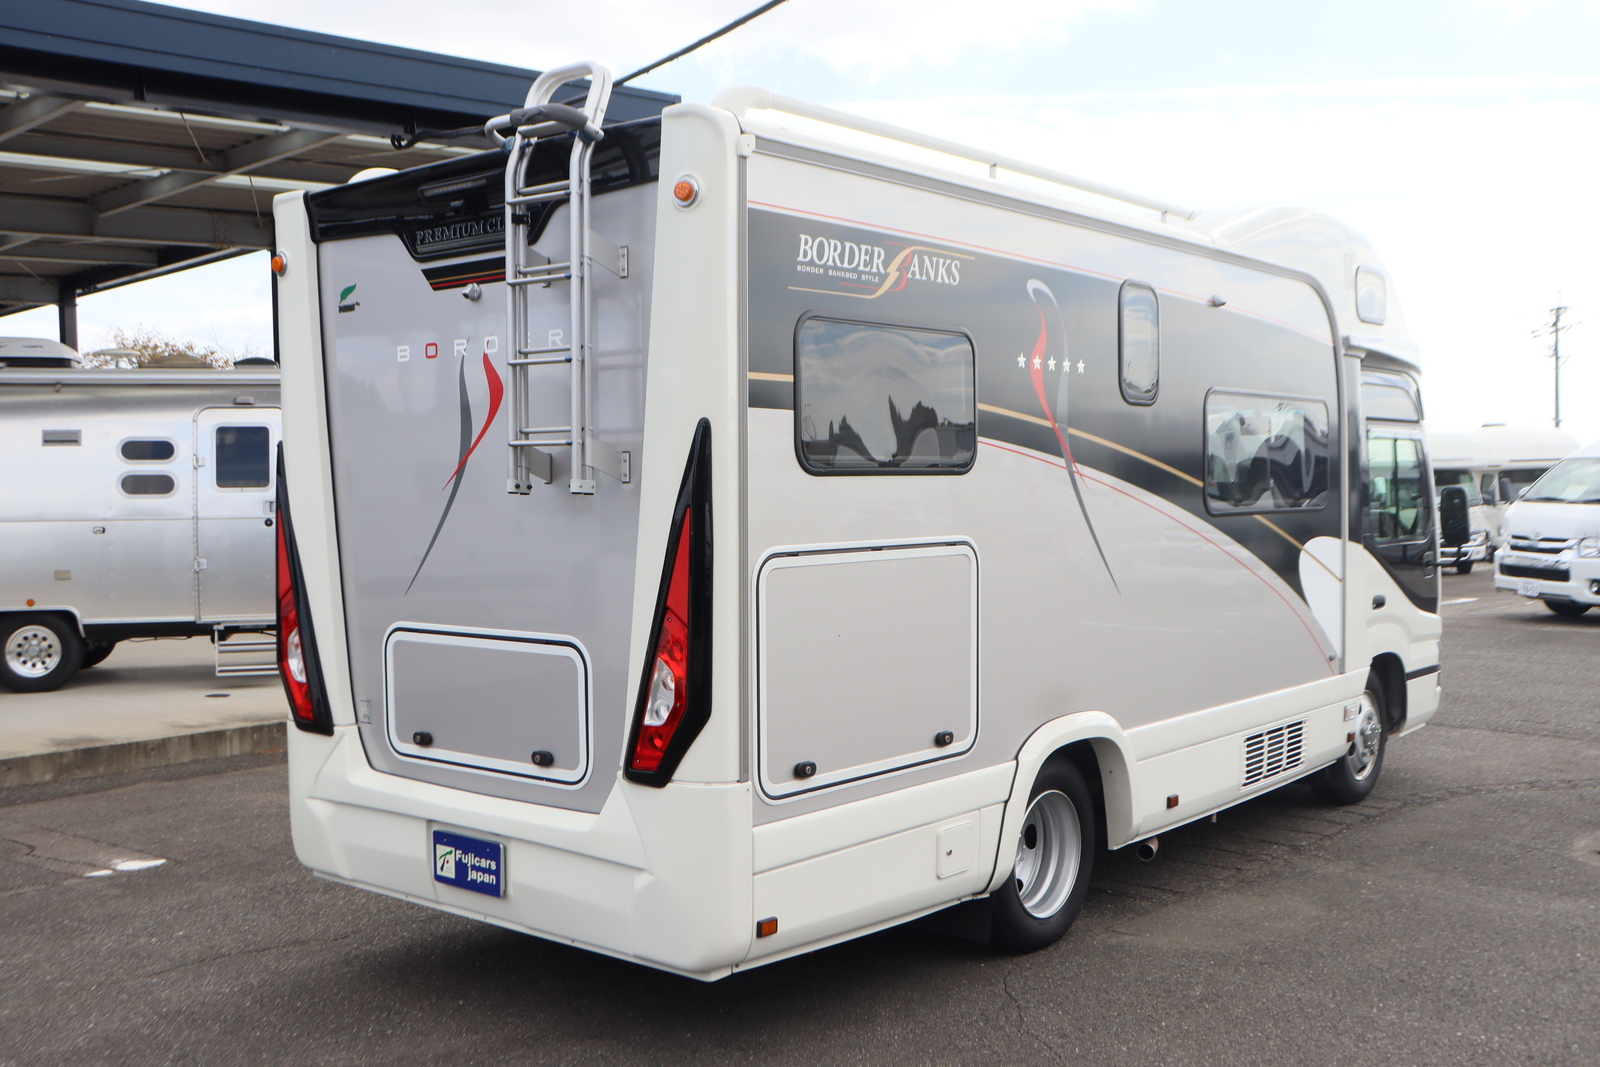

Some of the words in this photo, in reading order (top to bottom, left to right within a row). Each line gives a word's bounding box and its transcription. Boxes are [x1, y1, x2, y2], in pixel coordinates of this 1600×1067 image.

[415, 220, 484, 245] PREMIUM
[797, 234, 885, 274] BORDER
[796, 265, 824, 275] BORDER
[861, 274, 880, 283] STYLE
[397, 329, 563, 362] BORDR
[455, 849, 497, 870] Fujicars
